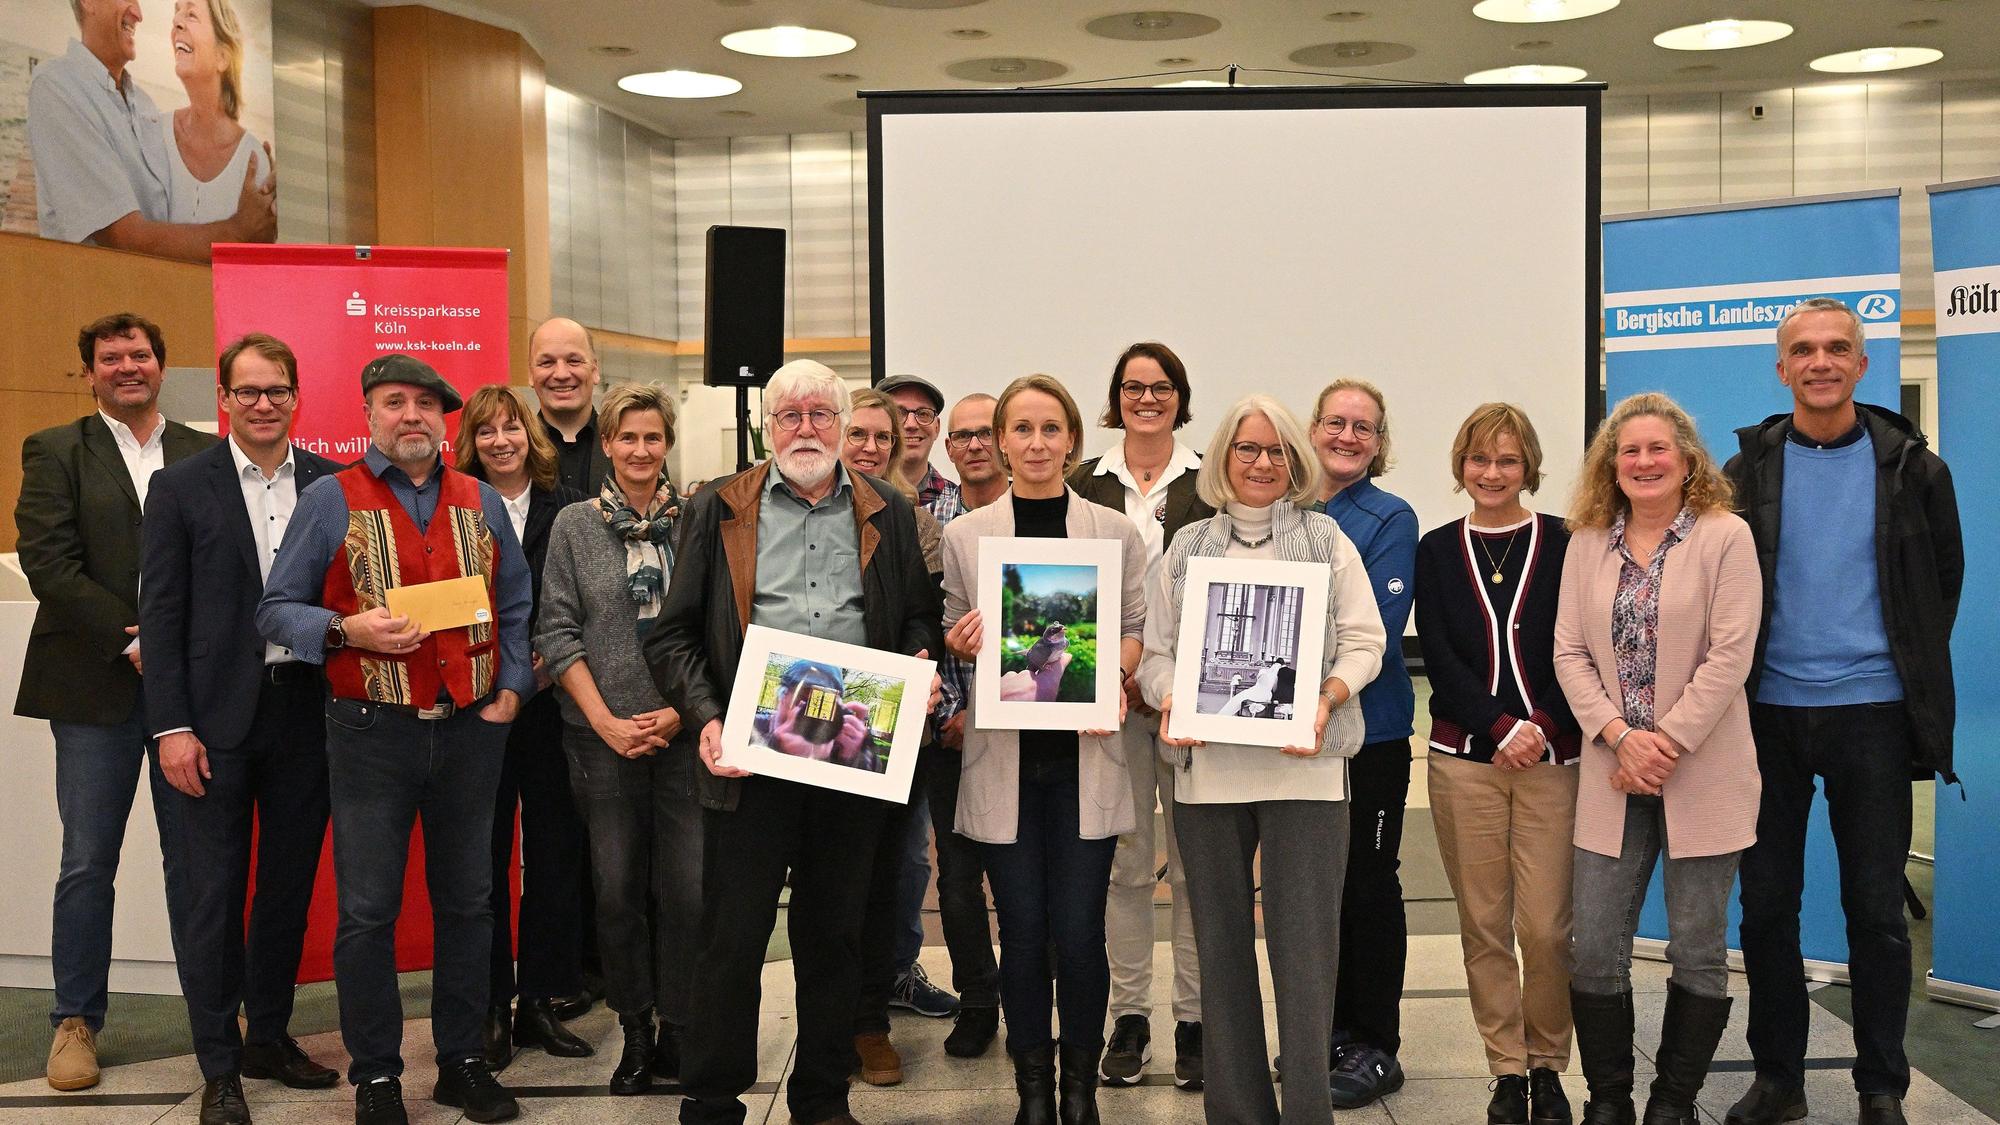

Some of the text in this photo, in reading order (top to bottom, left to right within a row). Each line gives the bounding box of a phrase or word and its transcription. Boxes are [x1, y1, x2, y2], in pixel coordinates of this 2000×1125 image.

[374, 304, 481, 319] Kreissparkasse
[1616, 304, 1703, 334] Bergische
[375, 321, 407, 334] Köln
[375, 341, 481, 351] www.ksk-koeln.de
[1375, 818, 1383, 850] MARTINI
